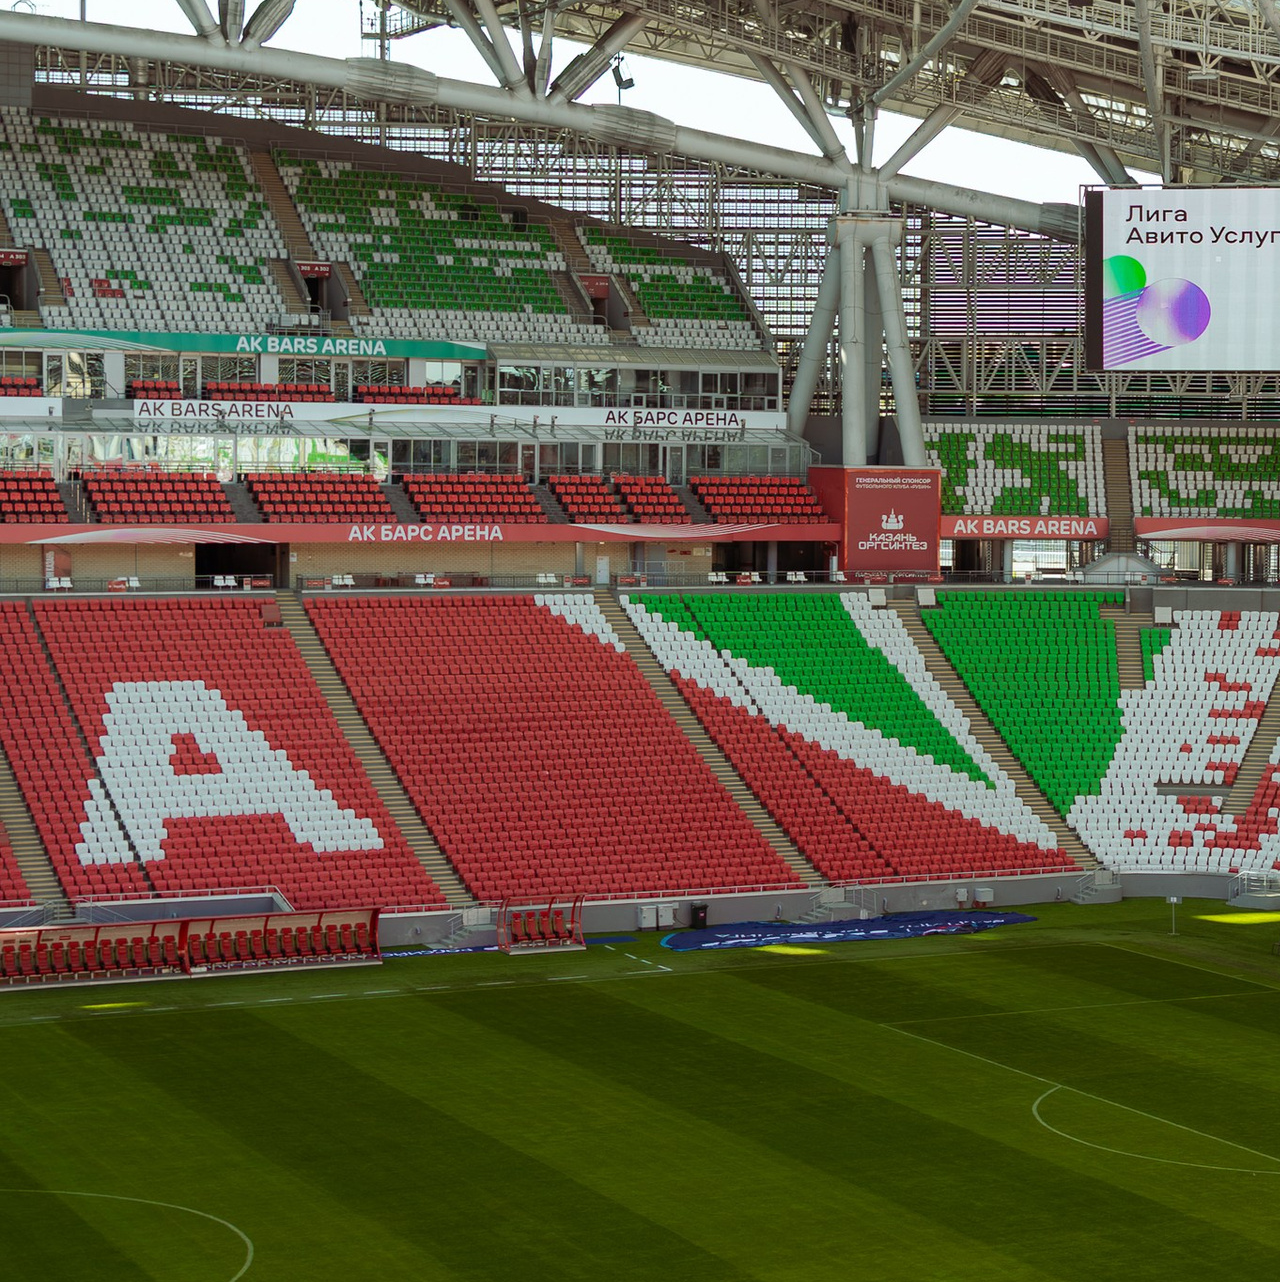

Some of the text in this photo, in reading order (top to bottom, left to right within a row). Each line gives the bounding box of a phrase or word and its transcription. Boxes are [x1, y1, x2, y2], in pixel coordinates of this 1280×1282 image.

[1125, 205, 1188, 223] Лига
[1125, 226, 1280, 248] Авито Услуг
[236, 335, 387, 356] AK BARS ARENA
[138, 402, 294, 418] AK BARS ARENA
[605, 410, 739, 426] АК БАРС АРЕНА
[348, 524, 503, 542] АК БАРС АРЕНА
[953, 519, 1098, 535] AK BARS ARENA
[858, 541, 928, 550] ОРГСИНТЕЗ
[869, 533, 917, 542] КАЗАНЬ
